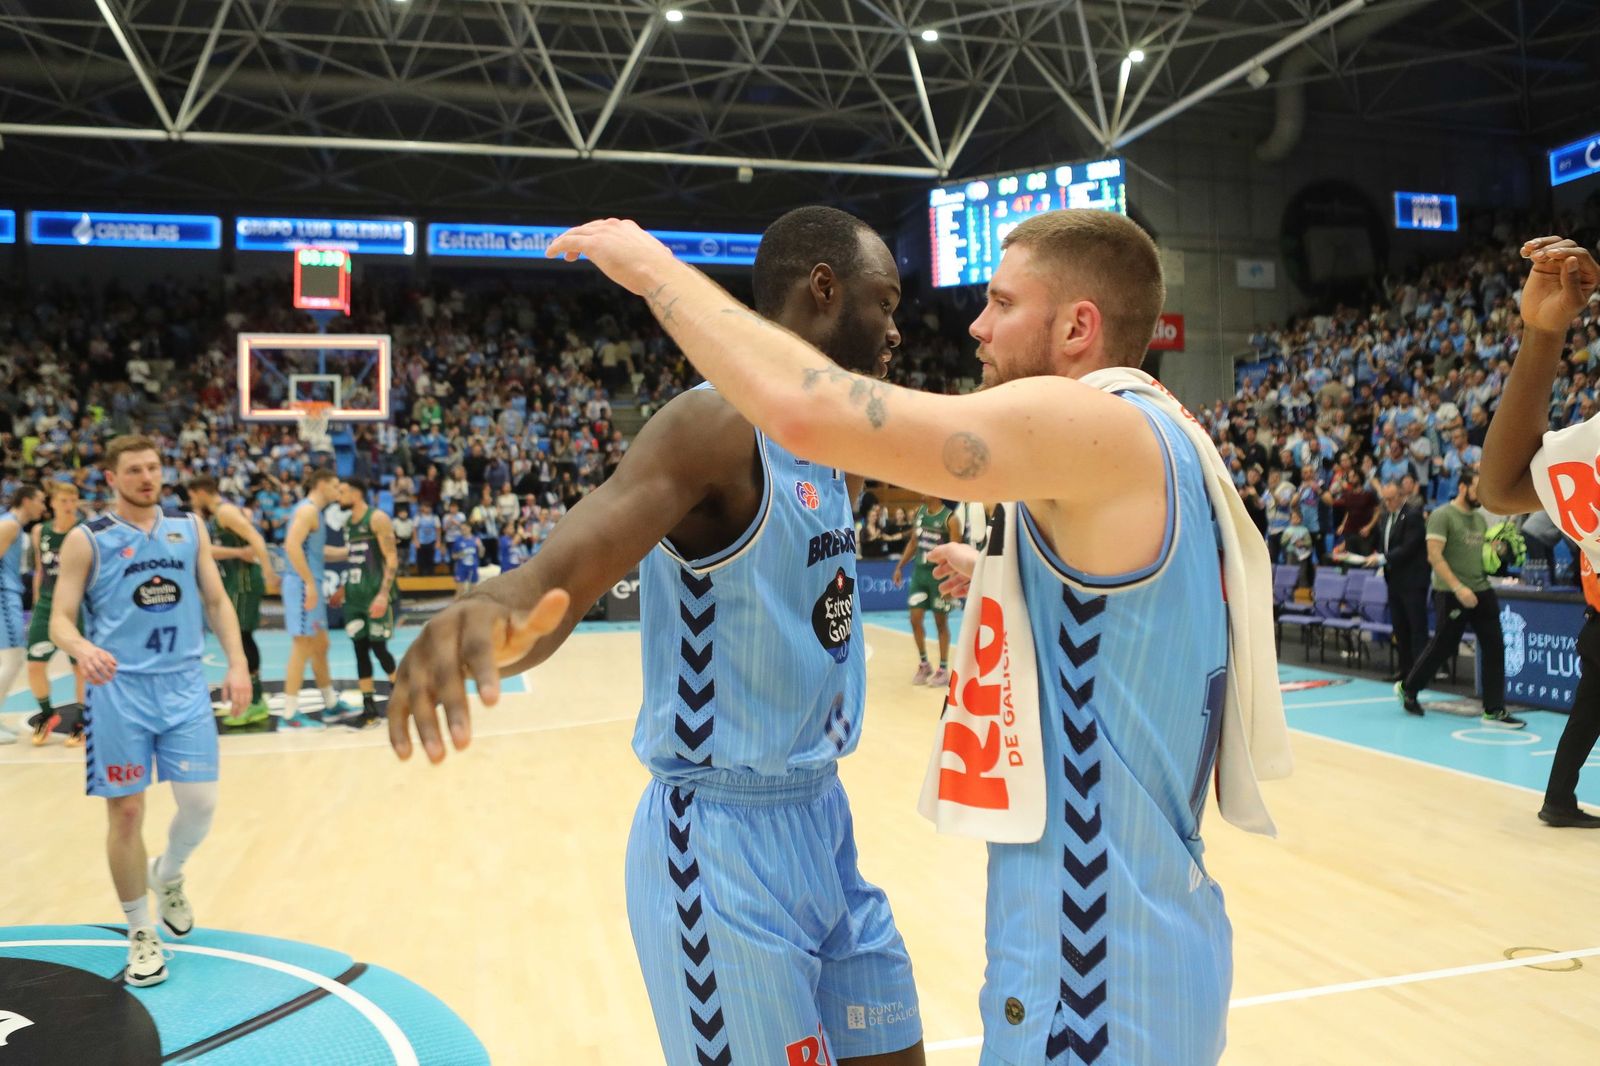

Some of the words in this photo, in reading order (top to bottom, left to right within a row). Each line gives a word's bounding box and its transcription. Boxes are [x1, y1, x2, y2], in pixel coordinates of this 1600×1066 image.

[438, 231, 505, 250] Estrella
[145, 626, 178, 654] 47
[1527, 632, 1579, 651] DEPUTA
[1506, 680, 1573, 703] ICEPRE
[1004, 734, 1024, 767] DE
[868, 999, 904, 1016] XUNTA
[868, 1015, 884, 1026] DE
